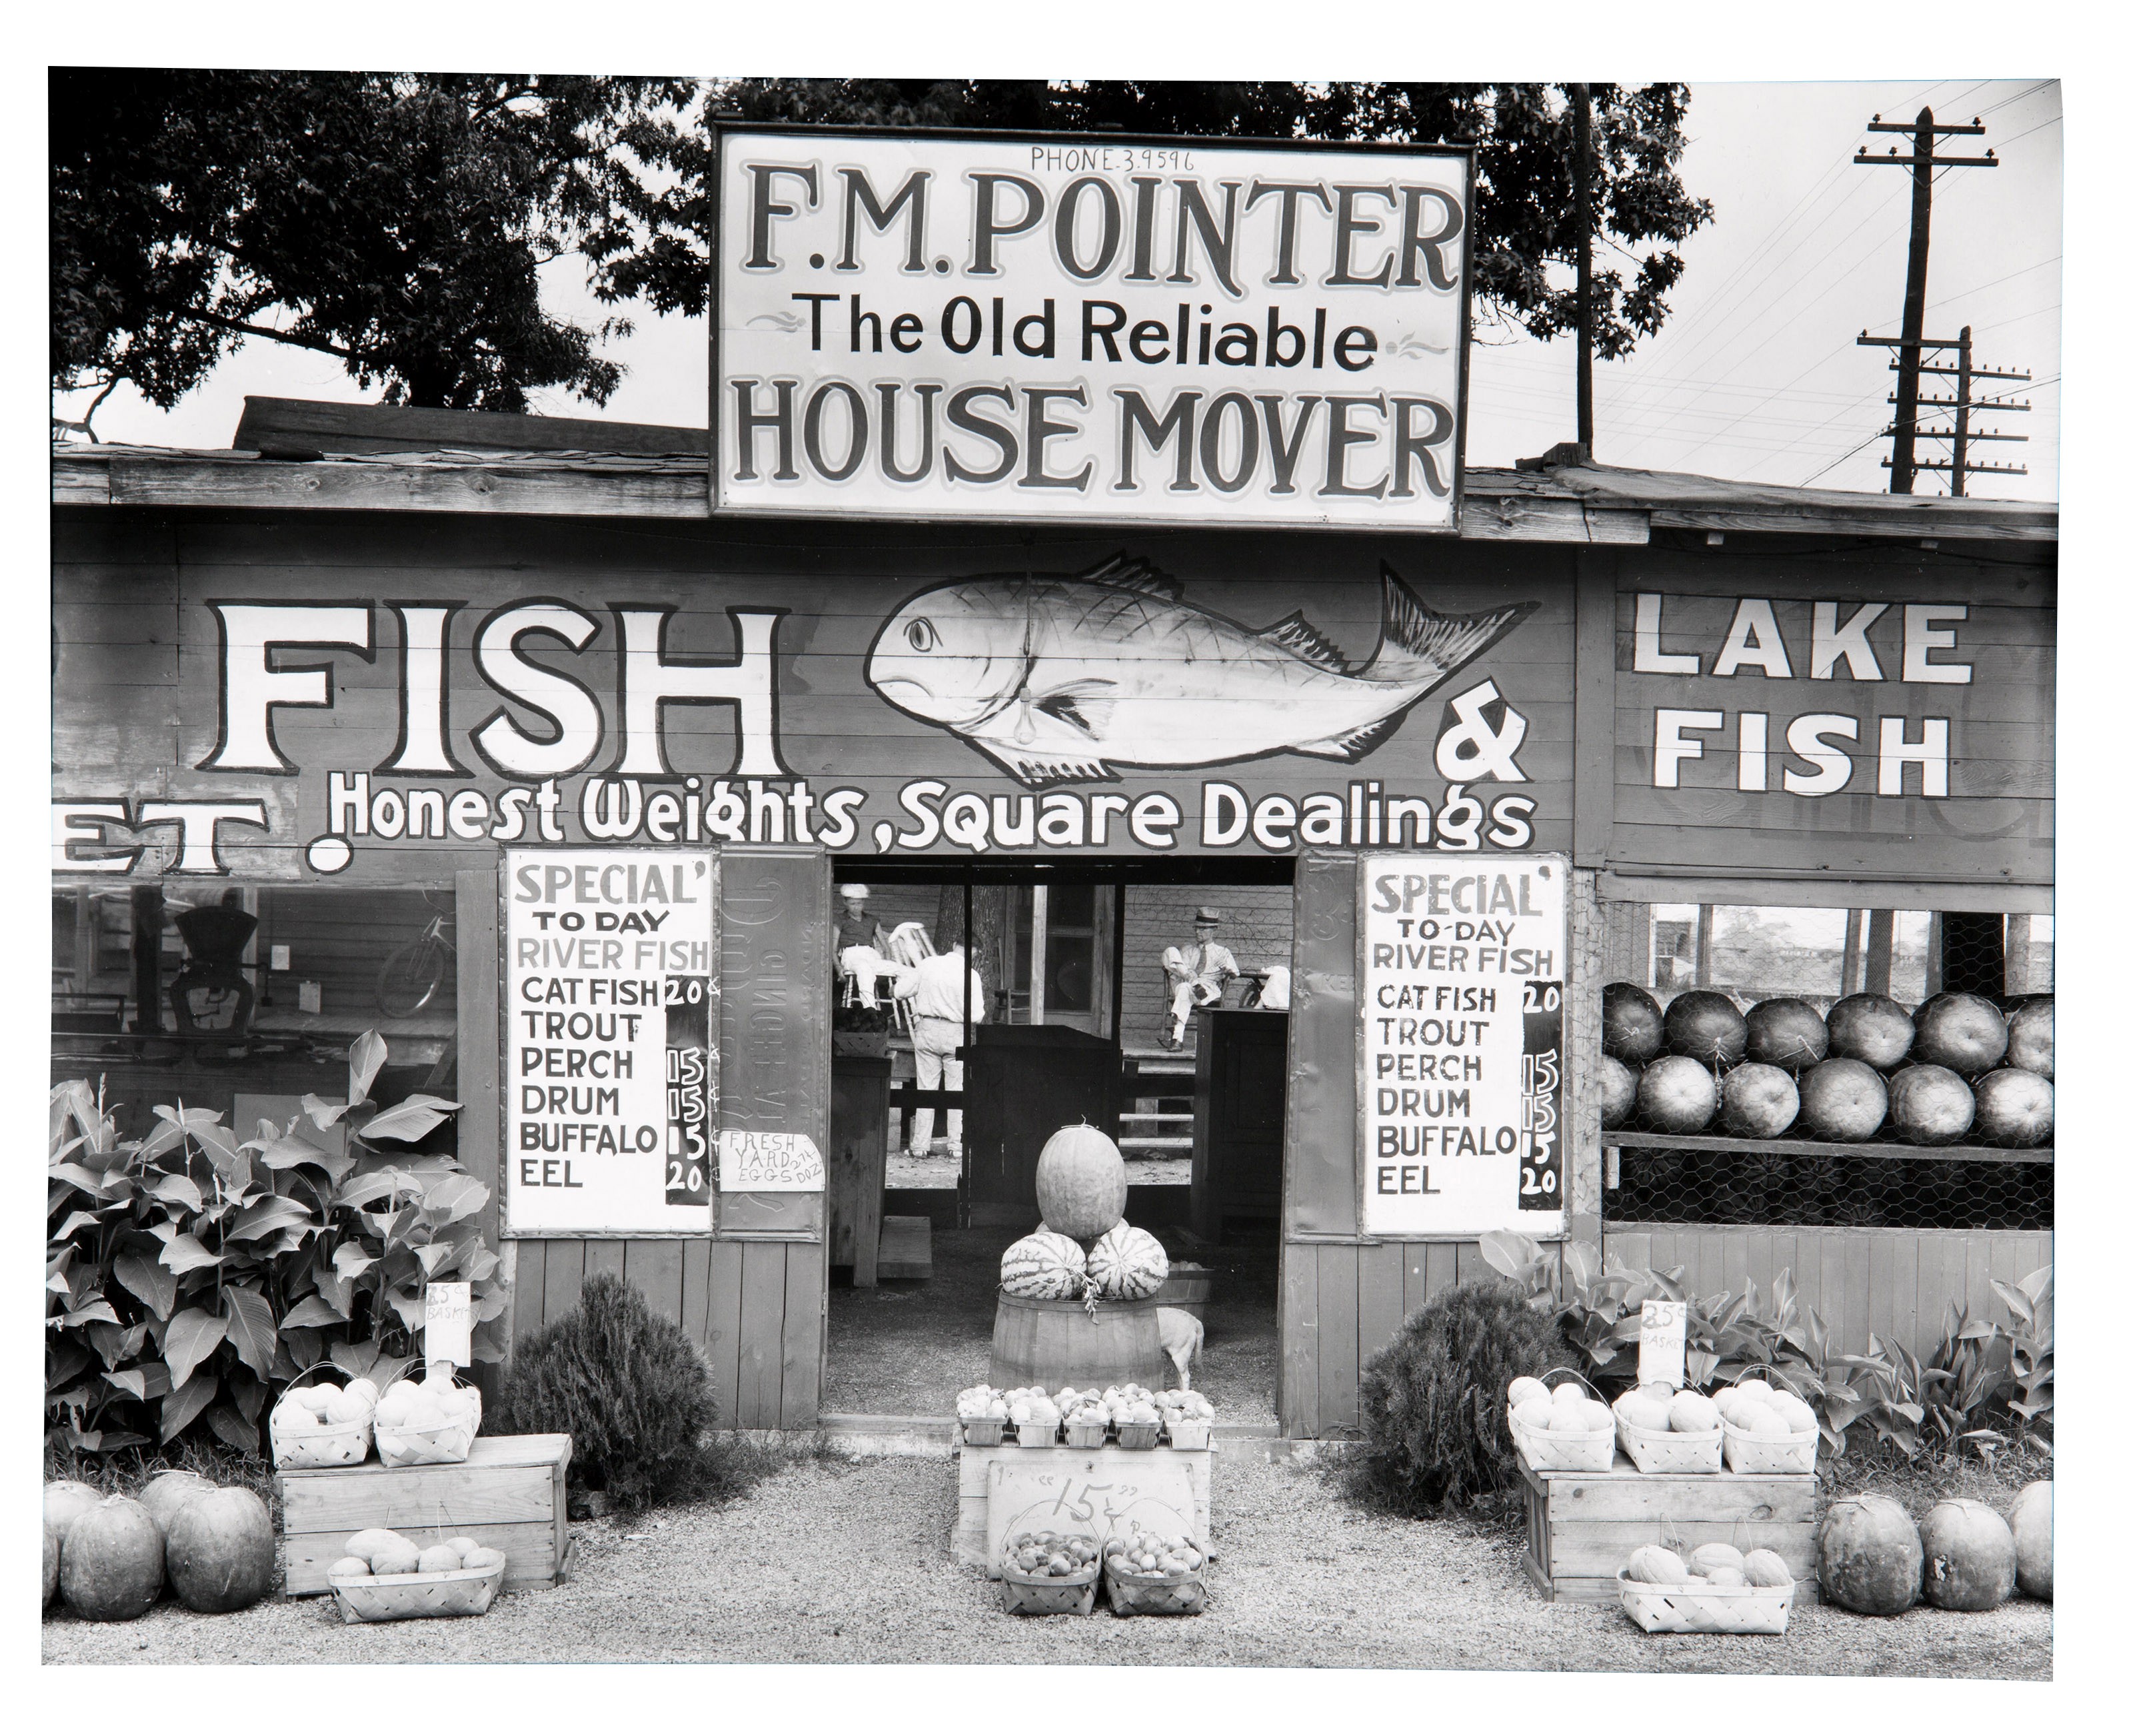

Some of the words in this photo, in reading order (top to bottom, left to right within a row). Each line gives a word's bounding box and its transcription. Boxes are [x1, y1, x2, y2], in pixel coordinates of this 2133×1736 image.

[967, 173, 1464, 298] POINTER
[791, 293, 923, 354] The
[941, 297, 1056, 360] Old
[1082, 300, 1378, 372] Reliable
[731, 379, 1093, 492] HOUSE
[1113, 390, 1453, 499] MOVER
[1632, 590, 1973, 684] LAKE
[195, 597, 793, 780] FISH
[1434, 676, 1533, 782] &
[1652, 707, 1950, 798] FISH
[329, 772, 564, 842] Honest
[1200, 779, 1538, 852] Dealings
[517, 937, 624, 970] RIVER
[635, 940, 709, 971] FISH
[1373, 943, 1469, 972] RIVER
[1478, 946, 1553, 976] FISH
[1524, 986, 1560, 1014] 20
[521, 1010, 642, 1042] TROUT
[1376, 1017, 1490, 1047] TROUT
[521, 1047, 633, 1080] PERCH
[1376, 1053, 1482, 1082] PERCH
[1522, 1048, 1559, 1096] 15
[521, 1085, 619, 1116] DRUM
[1377, 1088, 1471, 1118] DRUM
[1521, 1092, 1556, 1132] 15
[520, 1122, 659, 1156] BUFFALO
[730, 1132, 795, 1152] FRESH
[1377, 1125, 1518, 1159] BUFFALO
[1520, 1130, 1556, 1164] 15
[521, 1159, 583, 1188] EEL
[735, 1148, 790, 1170] YARD
[739, 1168, 793, 1183] EGGS
[796, 1162, 823, 1184] DOZ
[1377, 1166, 1441, 1195] EEL
[1520, 1167, 1556, 1195] 20
